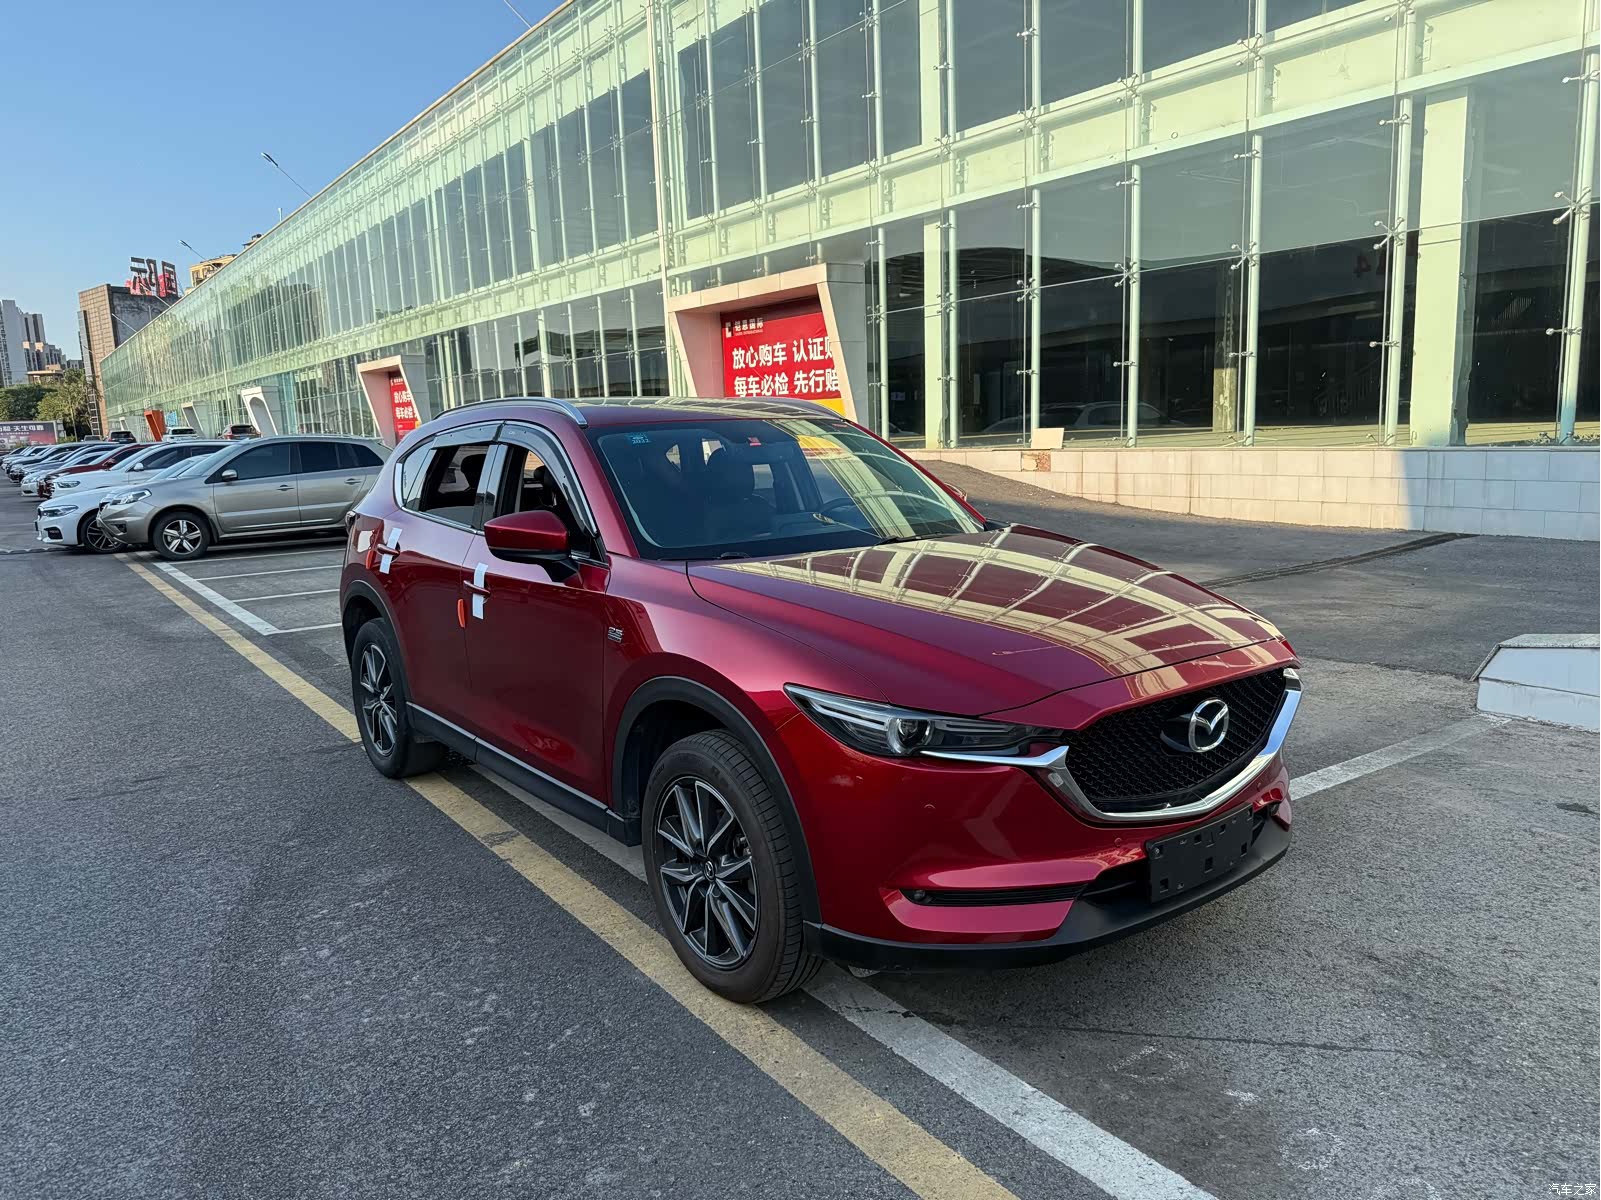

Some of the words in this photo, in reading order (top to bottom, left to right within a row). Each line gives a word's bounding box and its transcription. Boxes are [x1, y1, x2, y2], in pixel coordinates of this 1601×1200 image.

[732, 342, 787, 369] 放心购车
[734, 372, 789, 397] 每车必检
[793, 368, 840, 394] 先行赔
